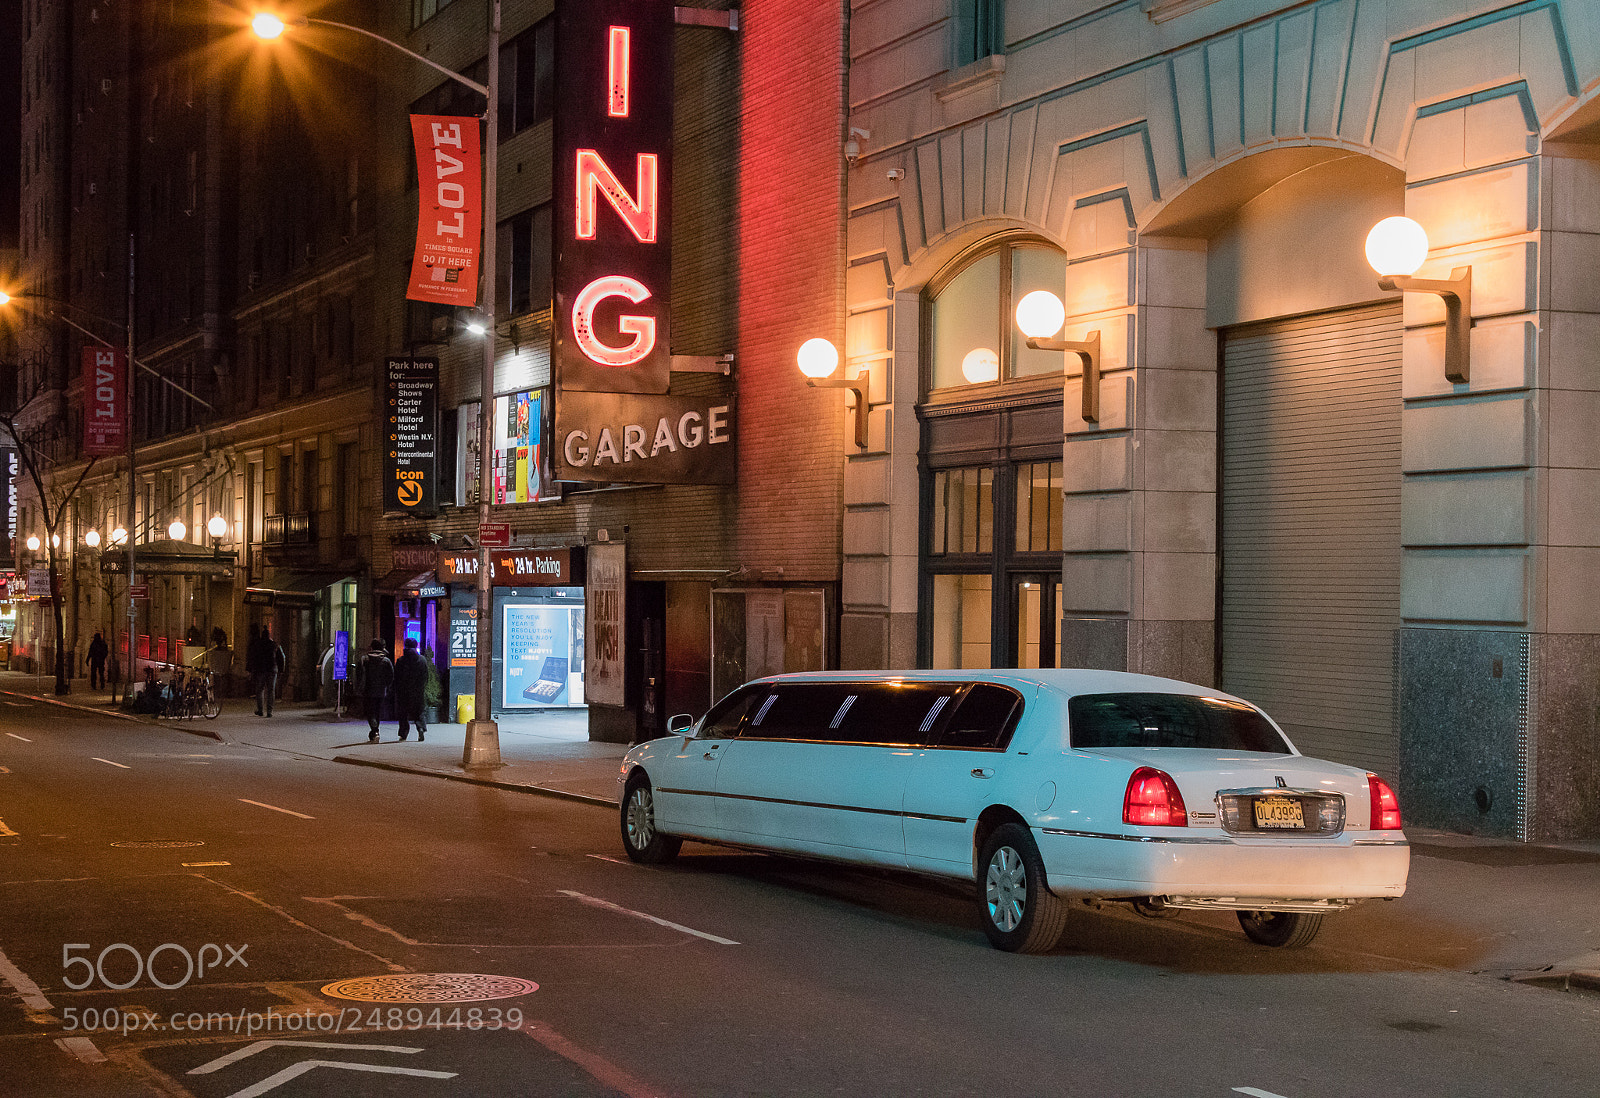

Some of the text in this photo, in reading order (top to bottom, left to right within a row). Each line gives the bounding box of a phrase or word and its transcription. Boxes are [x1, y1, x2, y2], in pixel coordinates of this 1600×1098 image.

[431, 122, 465, 238] LOVE
[424, 243, 473, 254] TIMES SQUARE
[422, 254, 472, 267] DO IT HERE
[389, 361, 434, 370] Park here
[96, 351, 114, 418] LOVE
[397, 382, 434, 390] Broadway
[398, 389, 423, 397] Shows
[397, 398, 422, 406] Carter
[397, 406, 418, 414] Hotel
[397, 415, 424, 423] Milford
[397, 423, 418, 431] Hotel
[564, 405, 730, 467] GARAGE
[395, 468, 424, 480] icon
[393, 551, 437, 565] PSYCHIC
[455, 557, 464, 574] 24
[464, 557, 473, 574] hr.
[515, 557, 525, 575] 24
[525, 556, 535, 574] hr.
[535, 556, 561, 578] Parking
[420, 586, 446, 596] PSYCHIC
